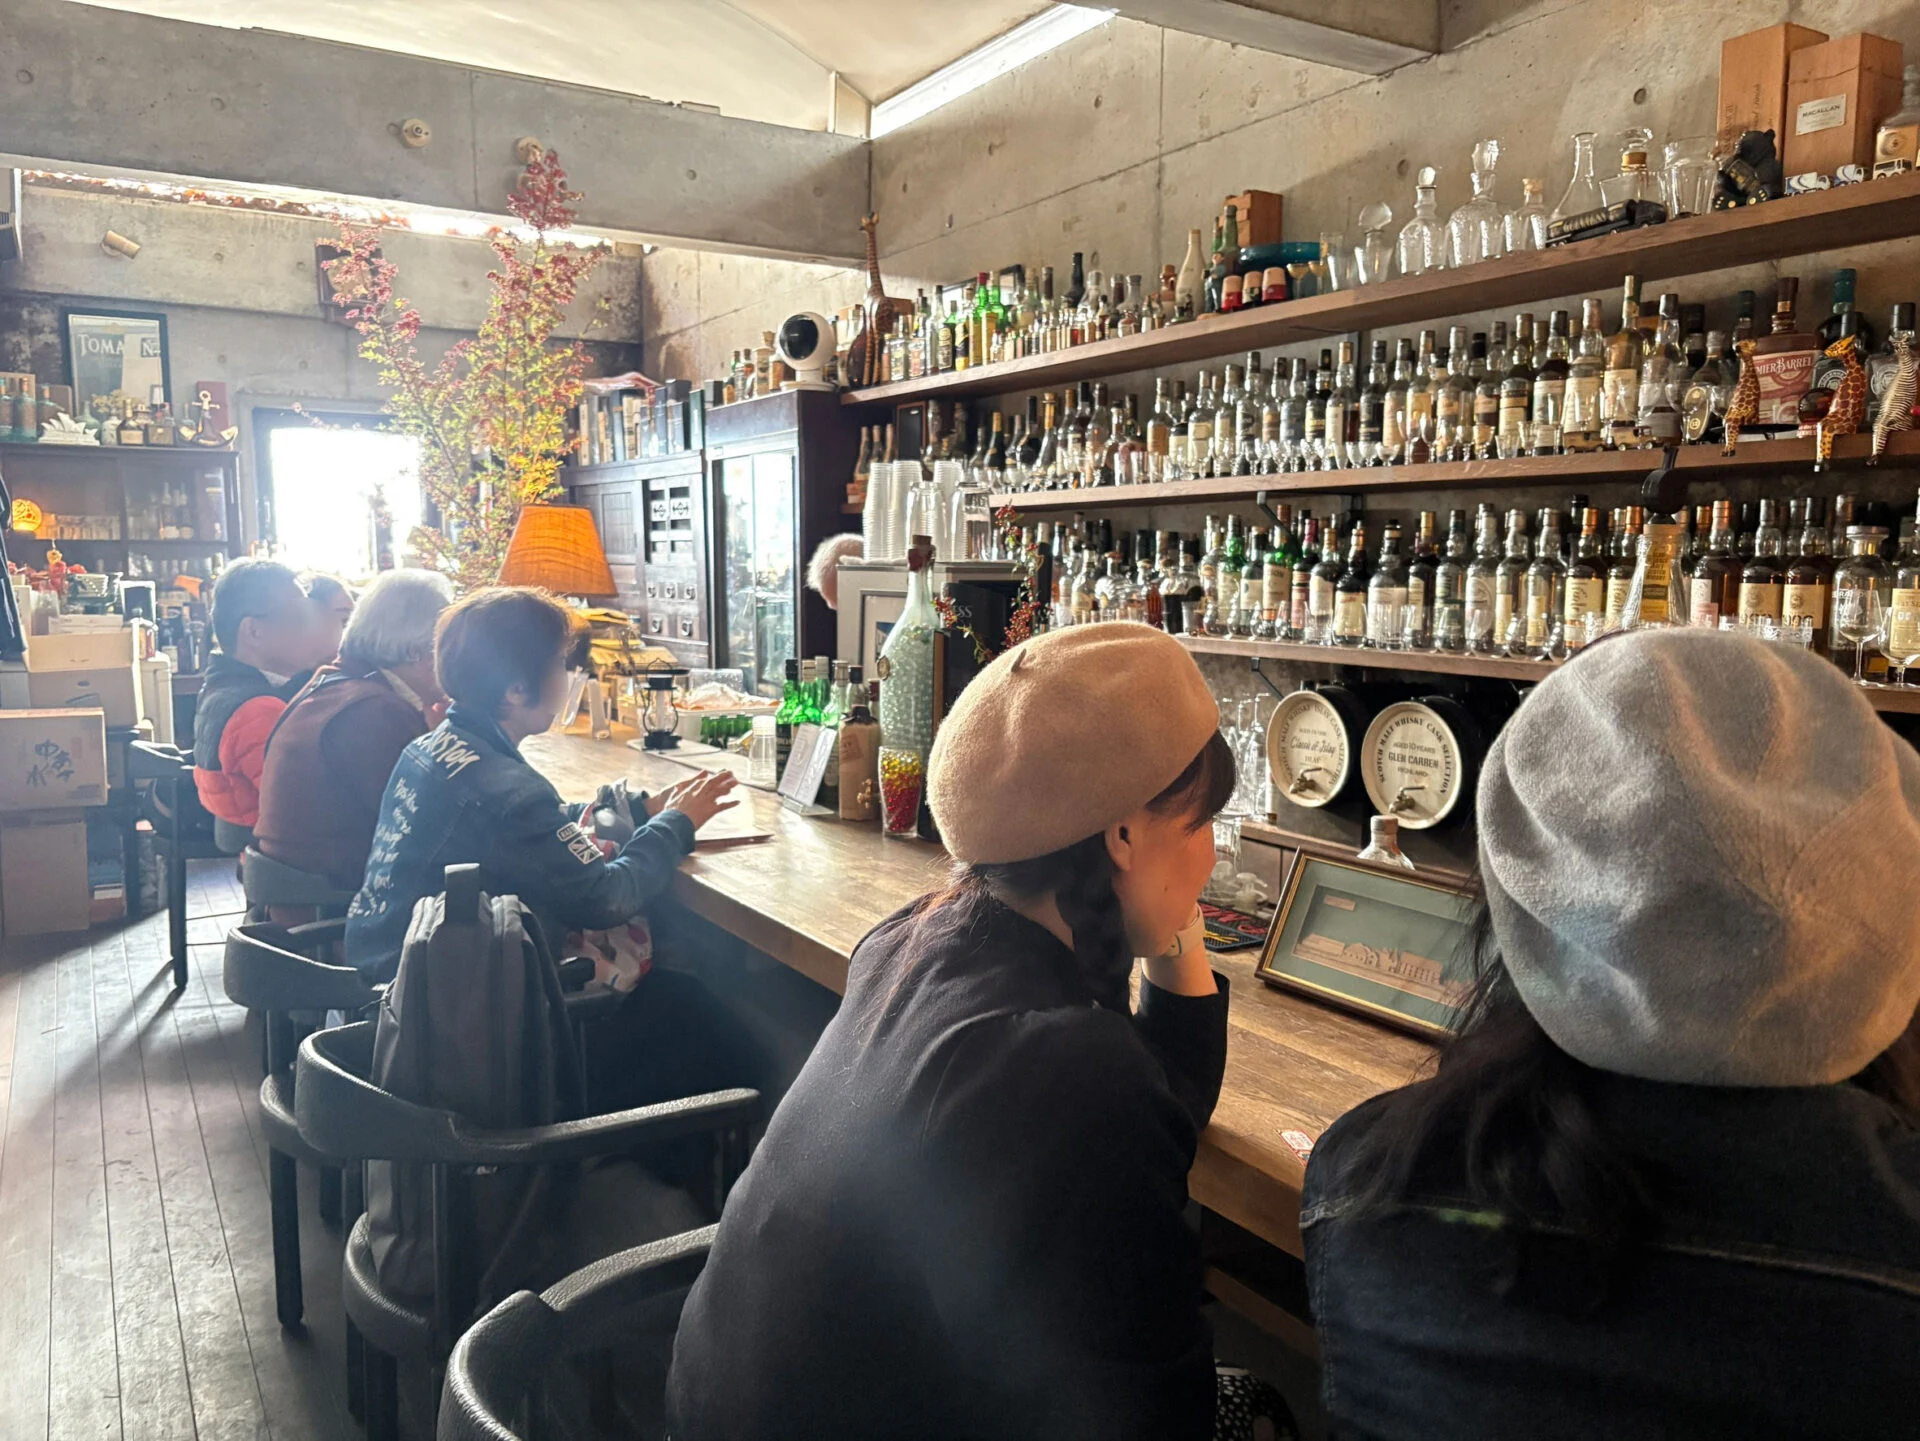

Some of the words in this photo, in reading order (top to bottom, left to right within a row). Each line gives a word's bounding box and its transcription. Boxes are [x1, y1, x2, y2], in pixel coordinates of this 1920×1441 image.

[1802, 105, 1841, 118] MACALLAN
[1776, 357, 1813, 374] BARREL
[1394, 716, 1423, 728] WHISKY
[1379, 725, 1394, 746] MALT
[1426, 722, 1443, 742] CASK
[1376, 748, 1385, 783] SCOTCH
[1388, 752, 1407, 763] GLEN
[1440, 743, 1452, 794] SELECTION
